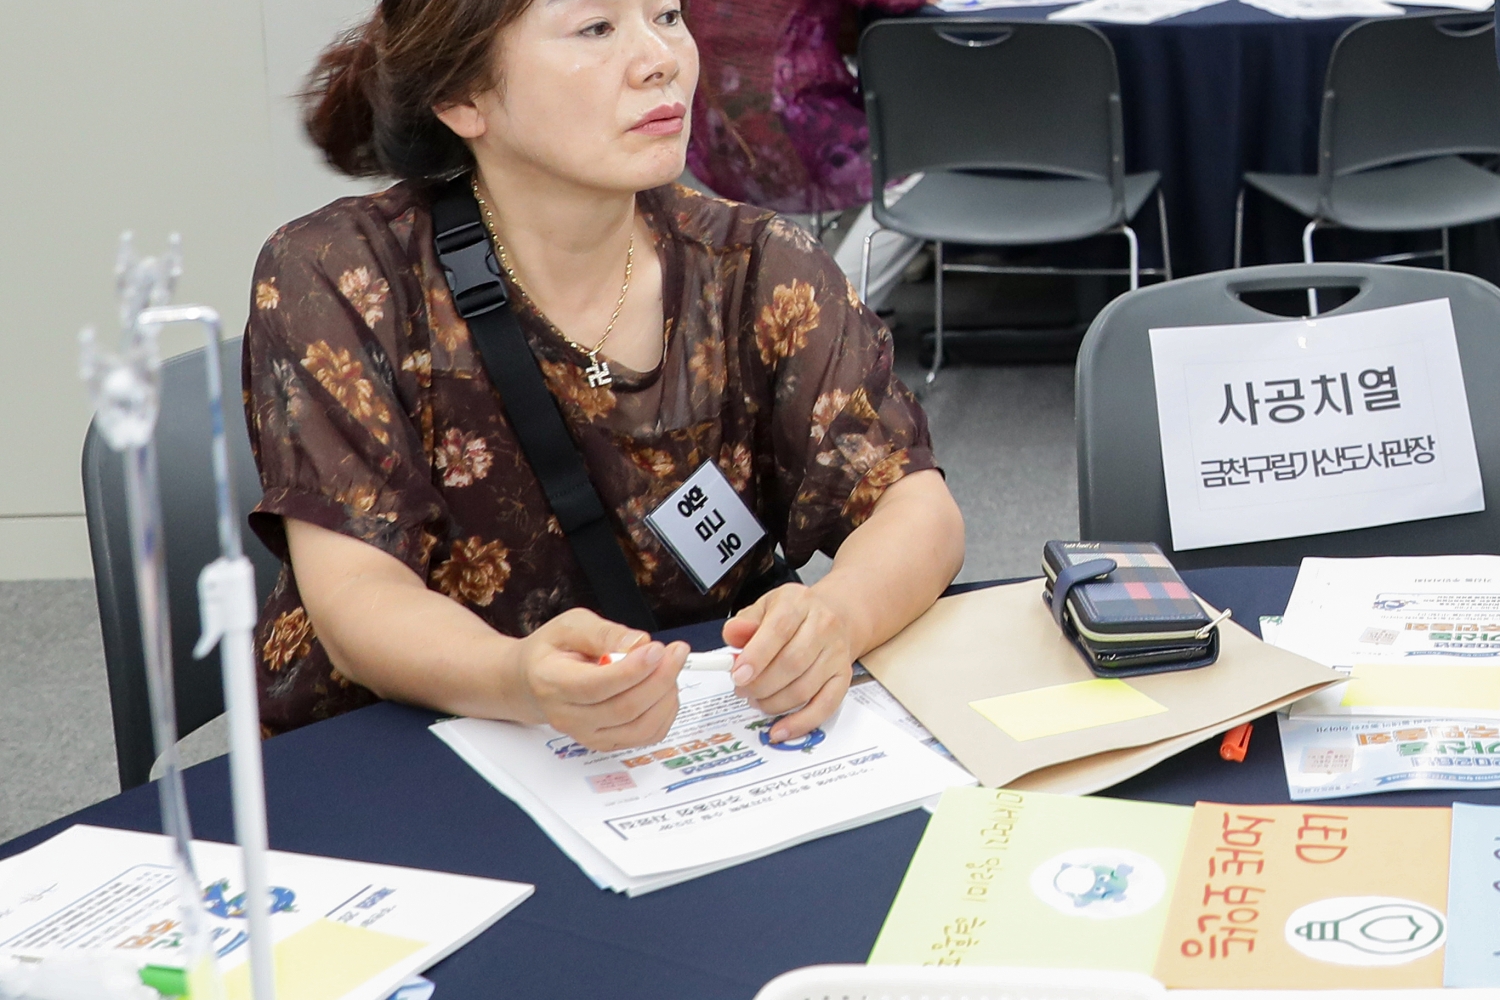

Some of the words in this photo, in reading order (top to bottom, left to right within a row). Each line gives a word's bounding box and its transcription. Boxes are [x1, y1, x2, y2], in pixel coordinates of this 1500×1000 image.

[1218, 366, 1402, 425] 사공치열
[1200, 434, 1435, 488] 금천구립가산도서관장
[677, 484, 741, 564] 황금옥
[662, 740, 750, 769] 가산동
[1356, 724, 1500, 746] 주민총회
[980, 791, 1024, 851] 미세먼지
[1208, 812, 1275, 878] 스마트
[1295, 813, 1349, 864] LED
[962, 857, 1001, 903] 알리미
[1181, 884, 1266, 961] 보안등
